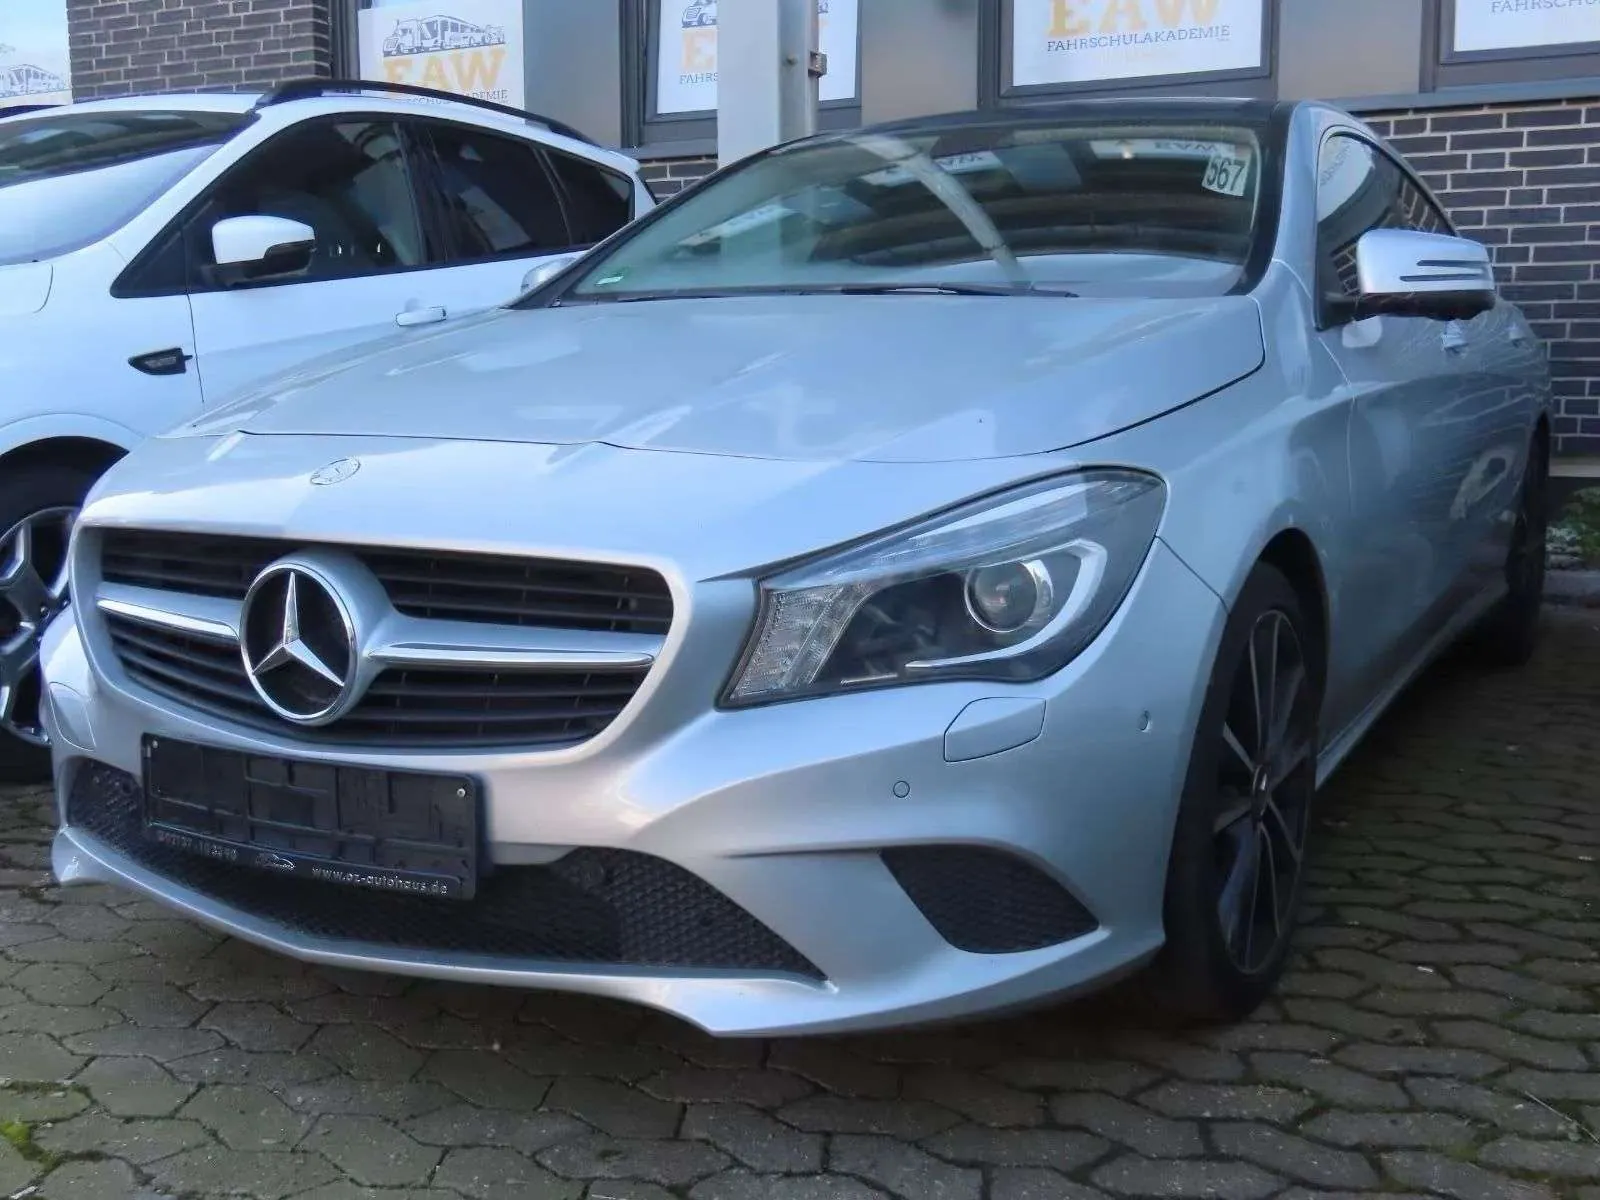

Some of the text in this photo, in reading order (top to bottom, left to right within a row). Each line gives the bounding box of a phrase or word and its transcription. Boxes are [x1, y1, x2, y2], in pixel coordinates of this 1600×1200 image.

[1048, 25, 1230, 51] FAHRSCHULAKADEMIE
[385, 47, 506, 89] EAW
[1206, 157, 1245, 192] 567
